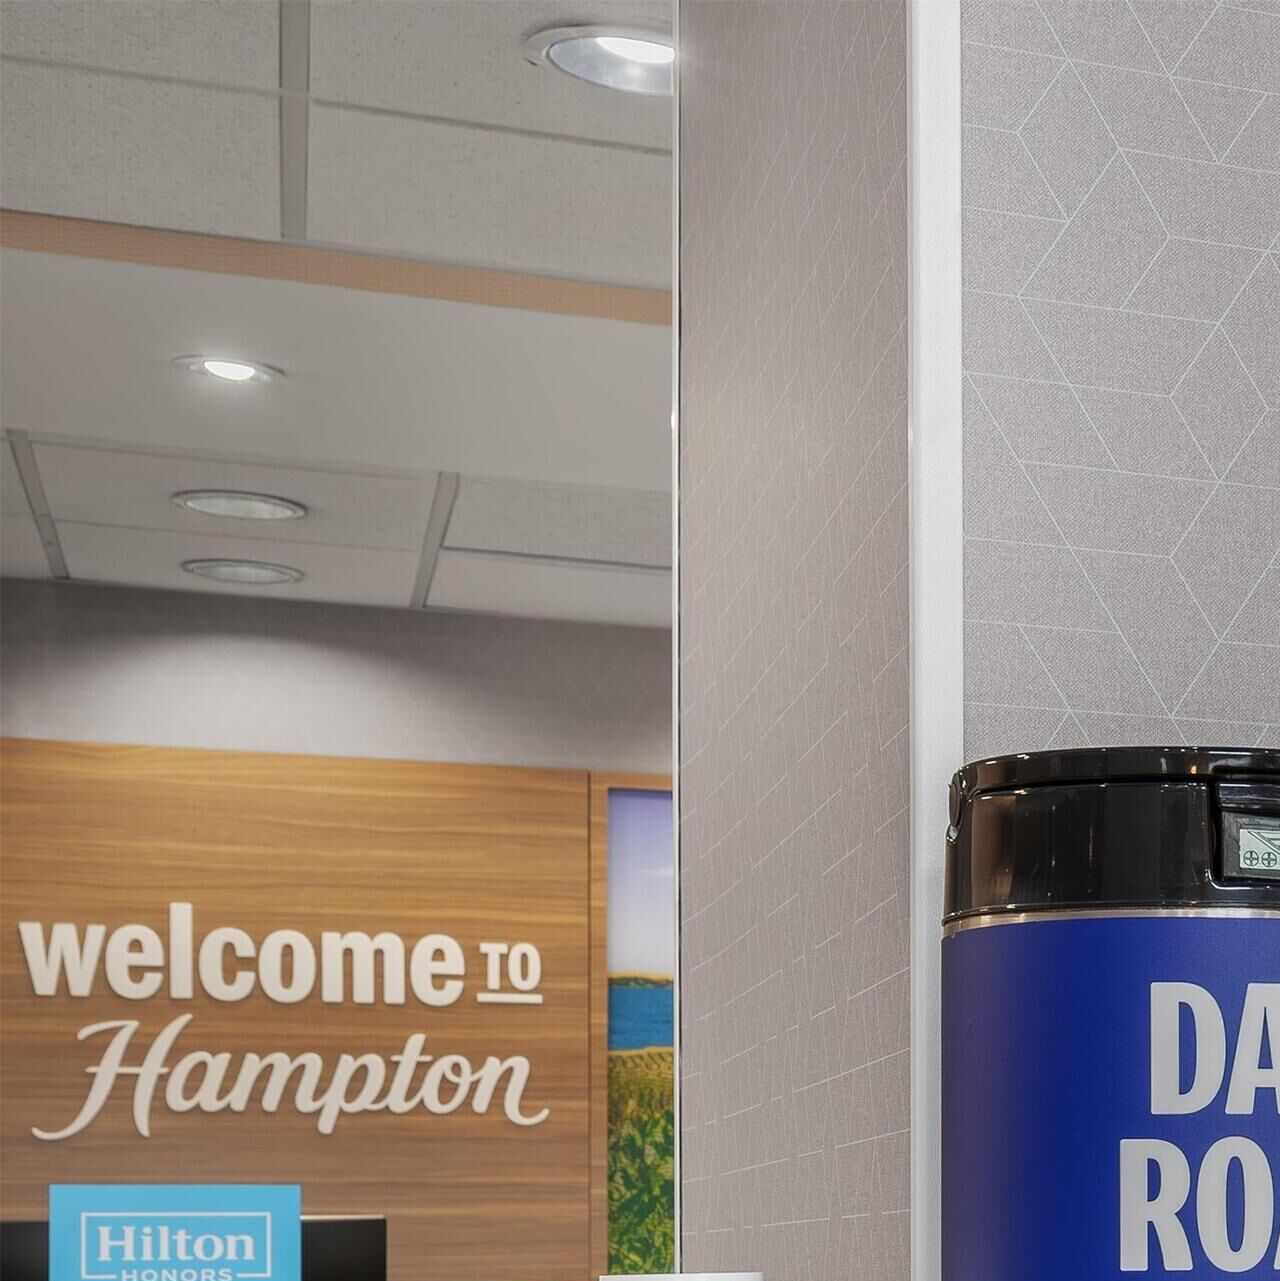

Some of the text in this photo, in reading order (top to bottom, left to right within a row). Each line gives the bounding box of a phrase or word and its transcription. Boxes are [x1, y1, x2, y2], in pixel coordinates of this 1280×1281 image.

[18, 902, 543, 1007] welcome TO
[31, 1013, 550, 1141] Hampton
[97, 1226, 256, 1262] Hilton
